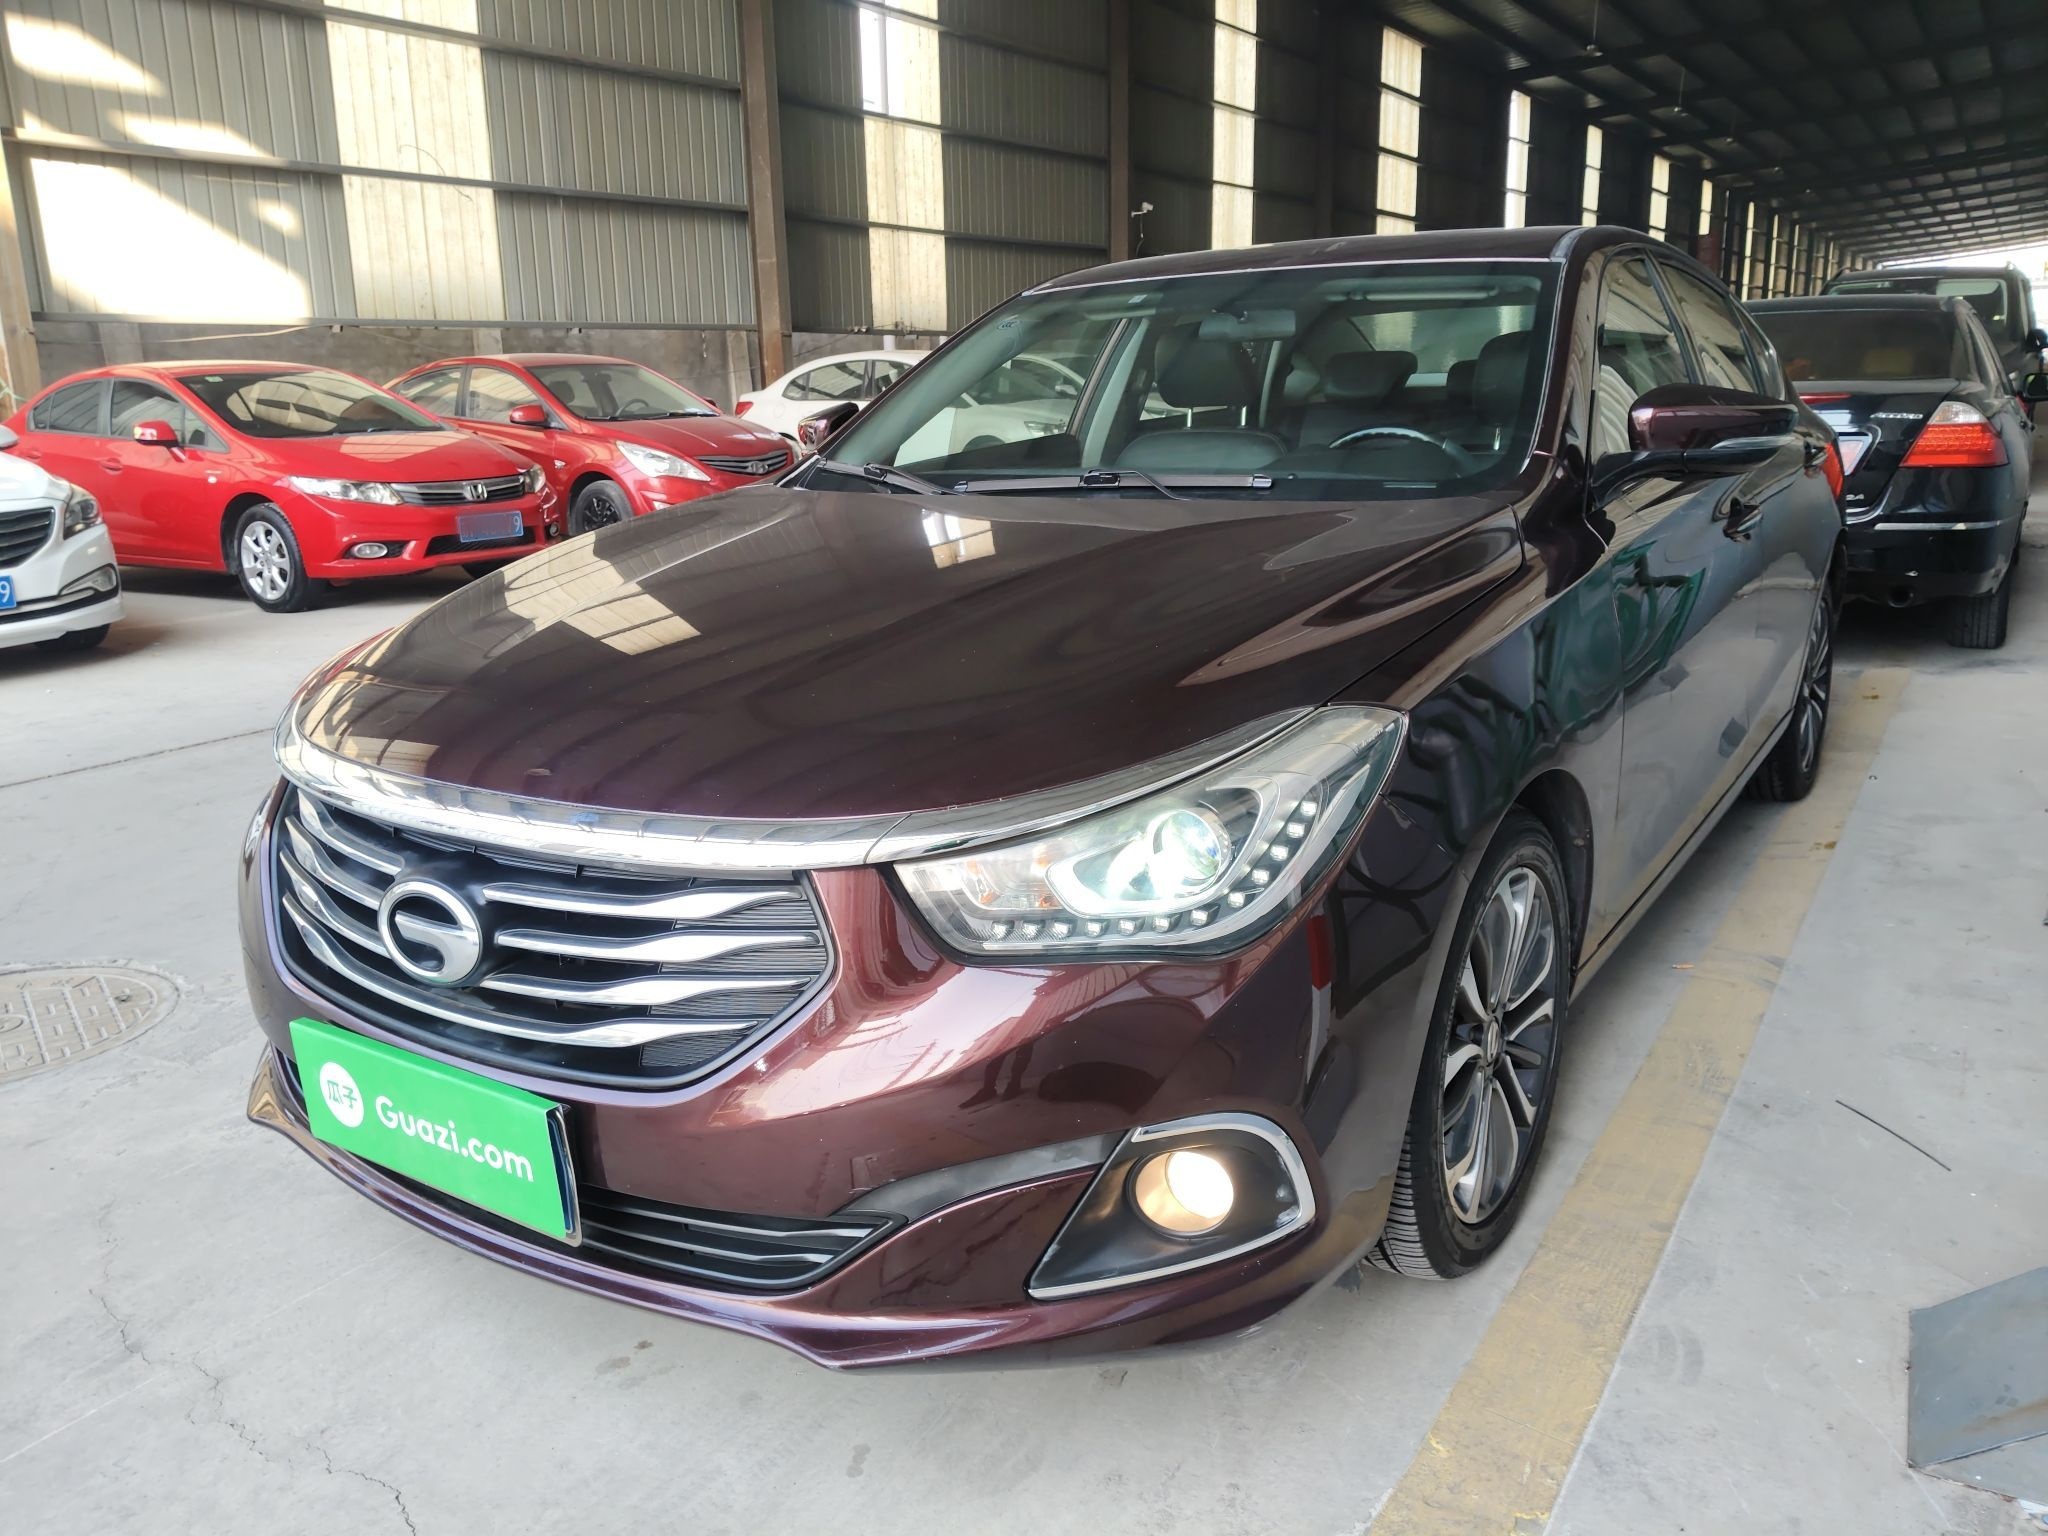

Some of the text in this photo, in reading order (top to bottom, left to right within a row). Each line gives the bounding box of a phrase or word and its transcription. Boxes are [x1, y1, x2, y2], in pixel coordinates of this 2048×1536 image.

[0, 581, 10, 603] 9
[326, 1079, 358, 1109] 瓜子
[375, 1095, 535, 1183] Guazi.com
